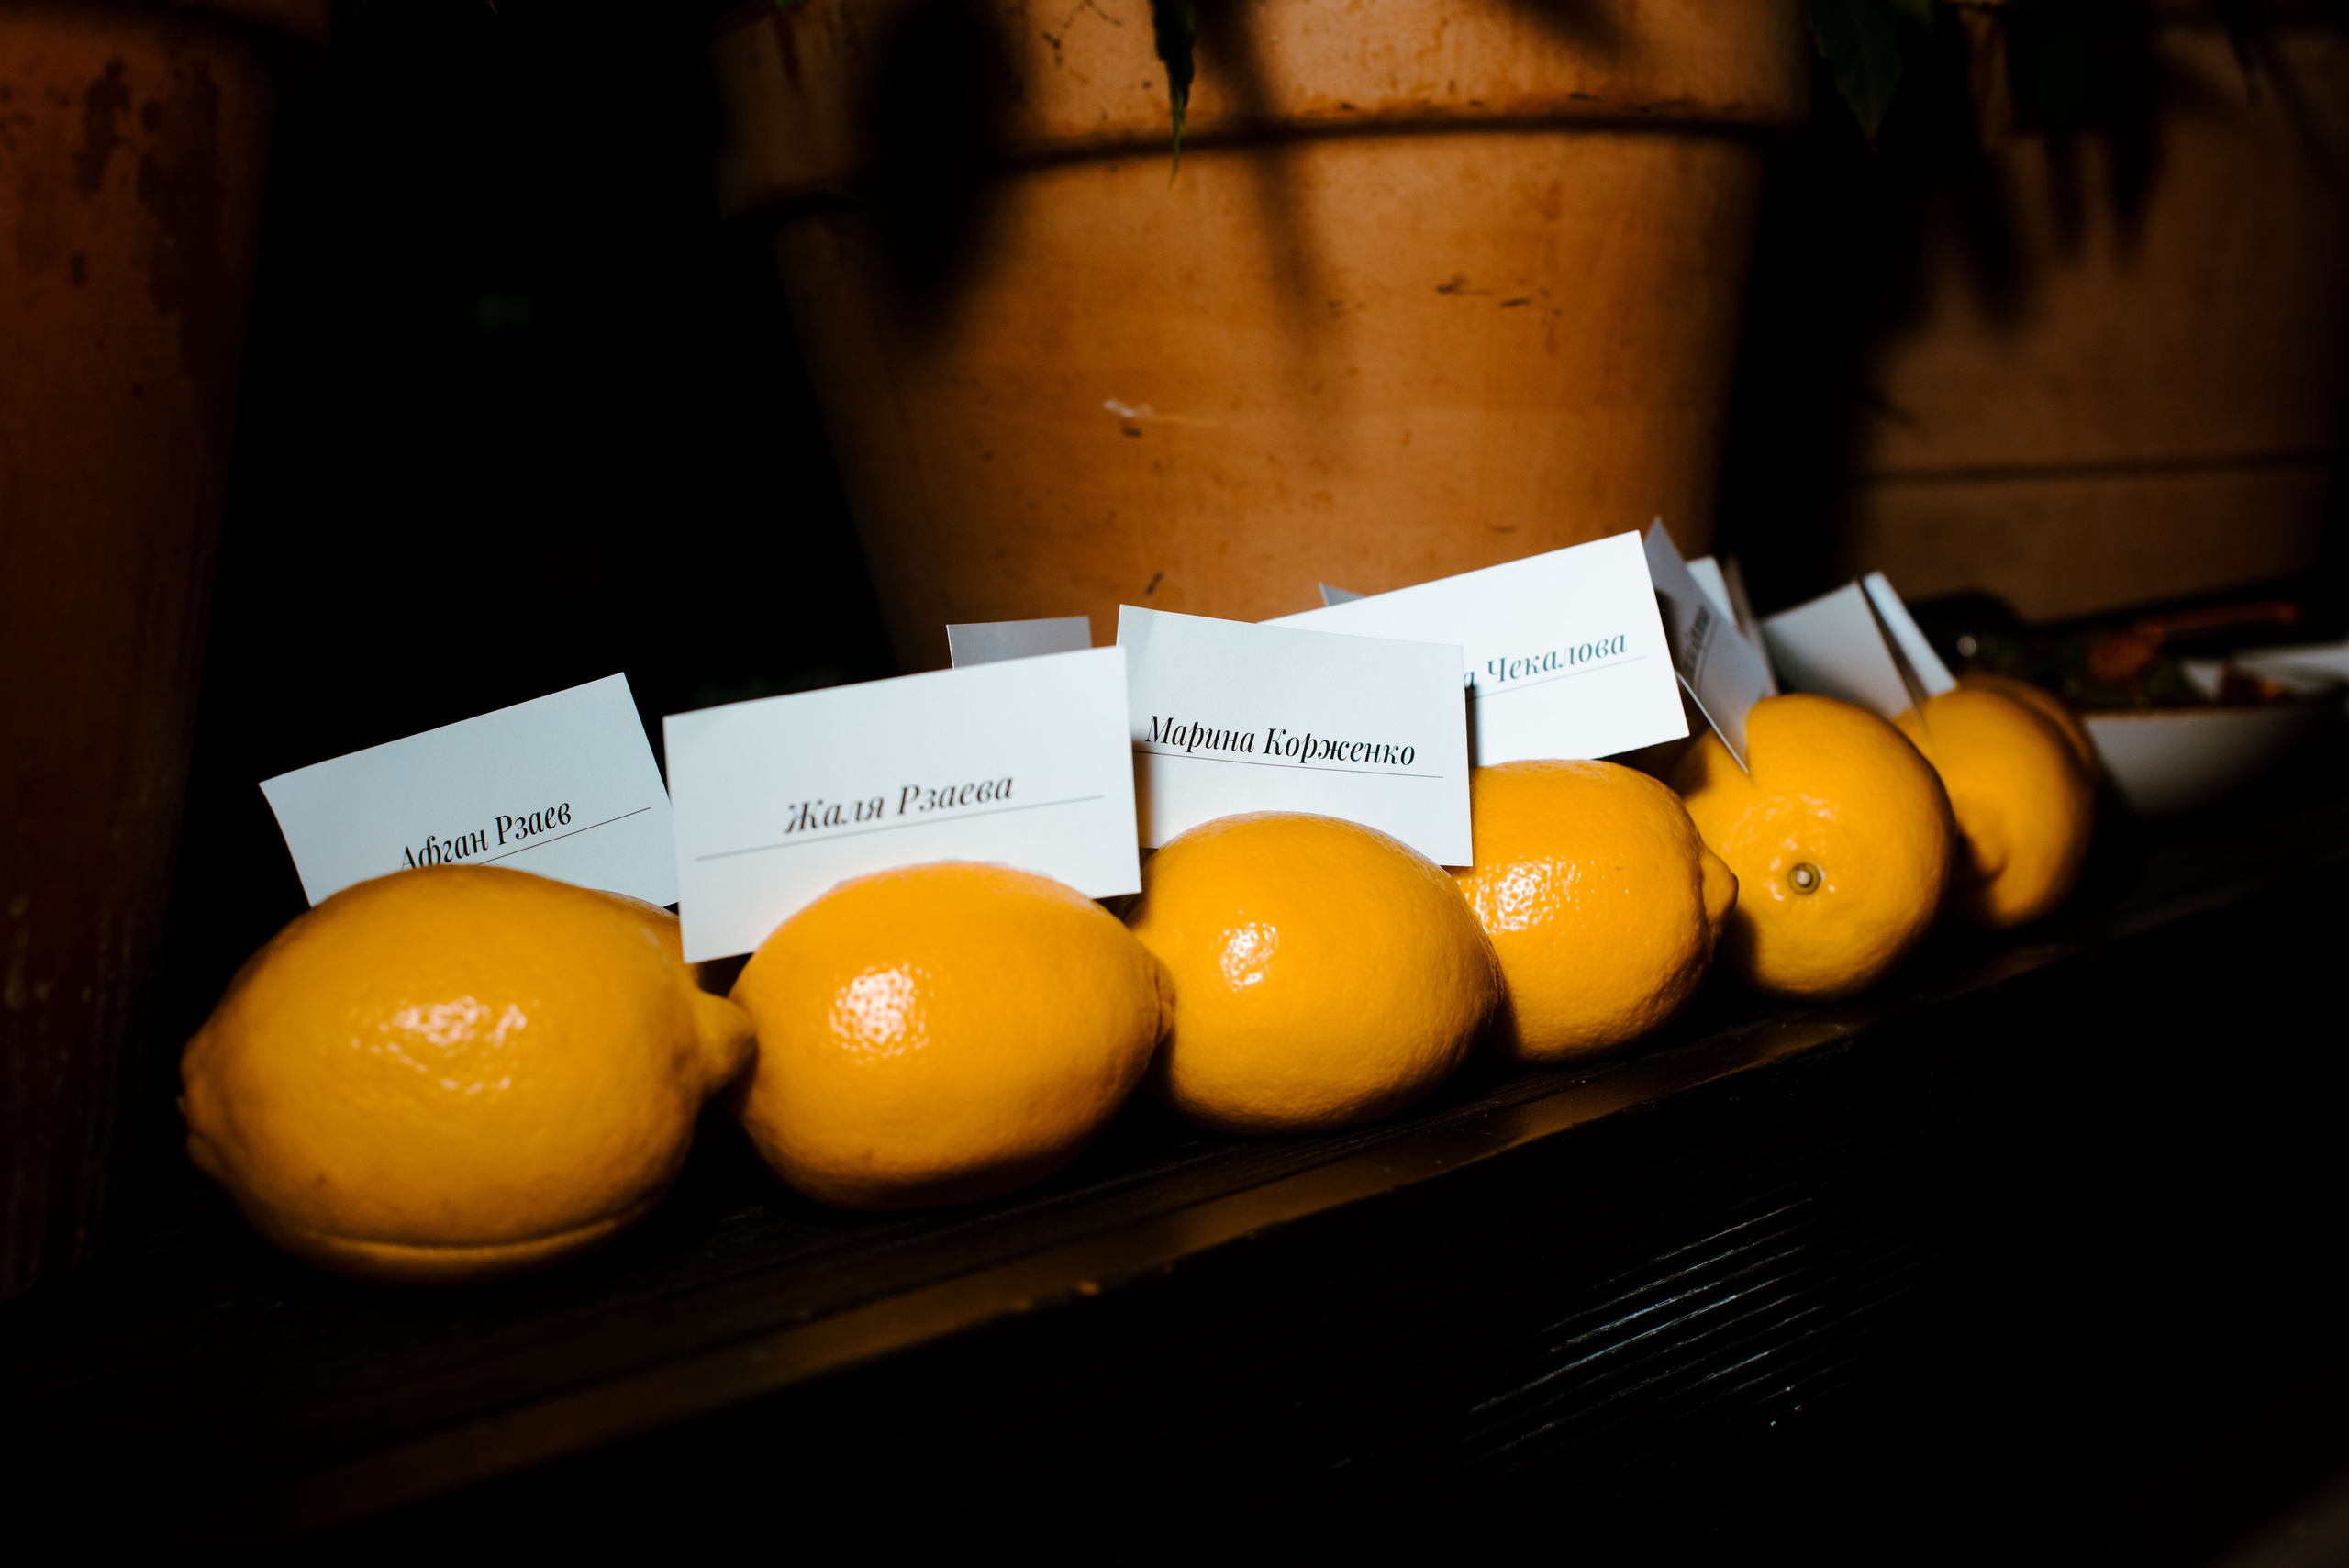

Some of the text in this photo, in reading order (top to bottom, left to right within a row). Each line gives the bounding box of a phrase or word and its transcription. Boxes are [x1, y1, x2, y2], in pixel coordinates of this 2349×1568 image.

[1487, 633, 1627, 684] Чекалова
[1145, 715, 1415, 765] Марина Корженко
[784, 777, 1014, 834] Жаля Рзаева
[401, 802, 572, 871] Афган Рзаев
